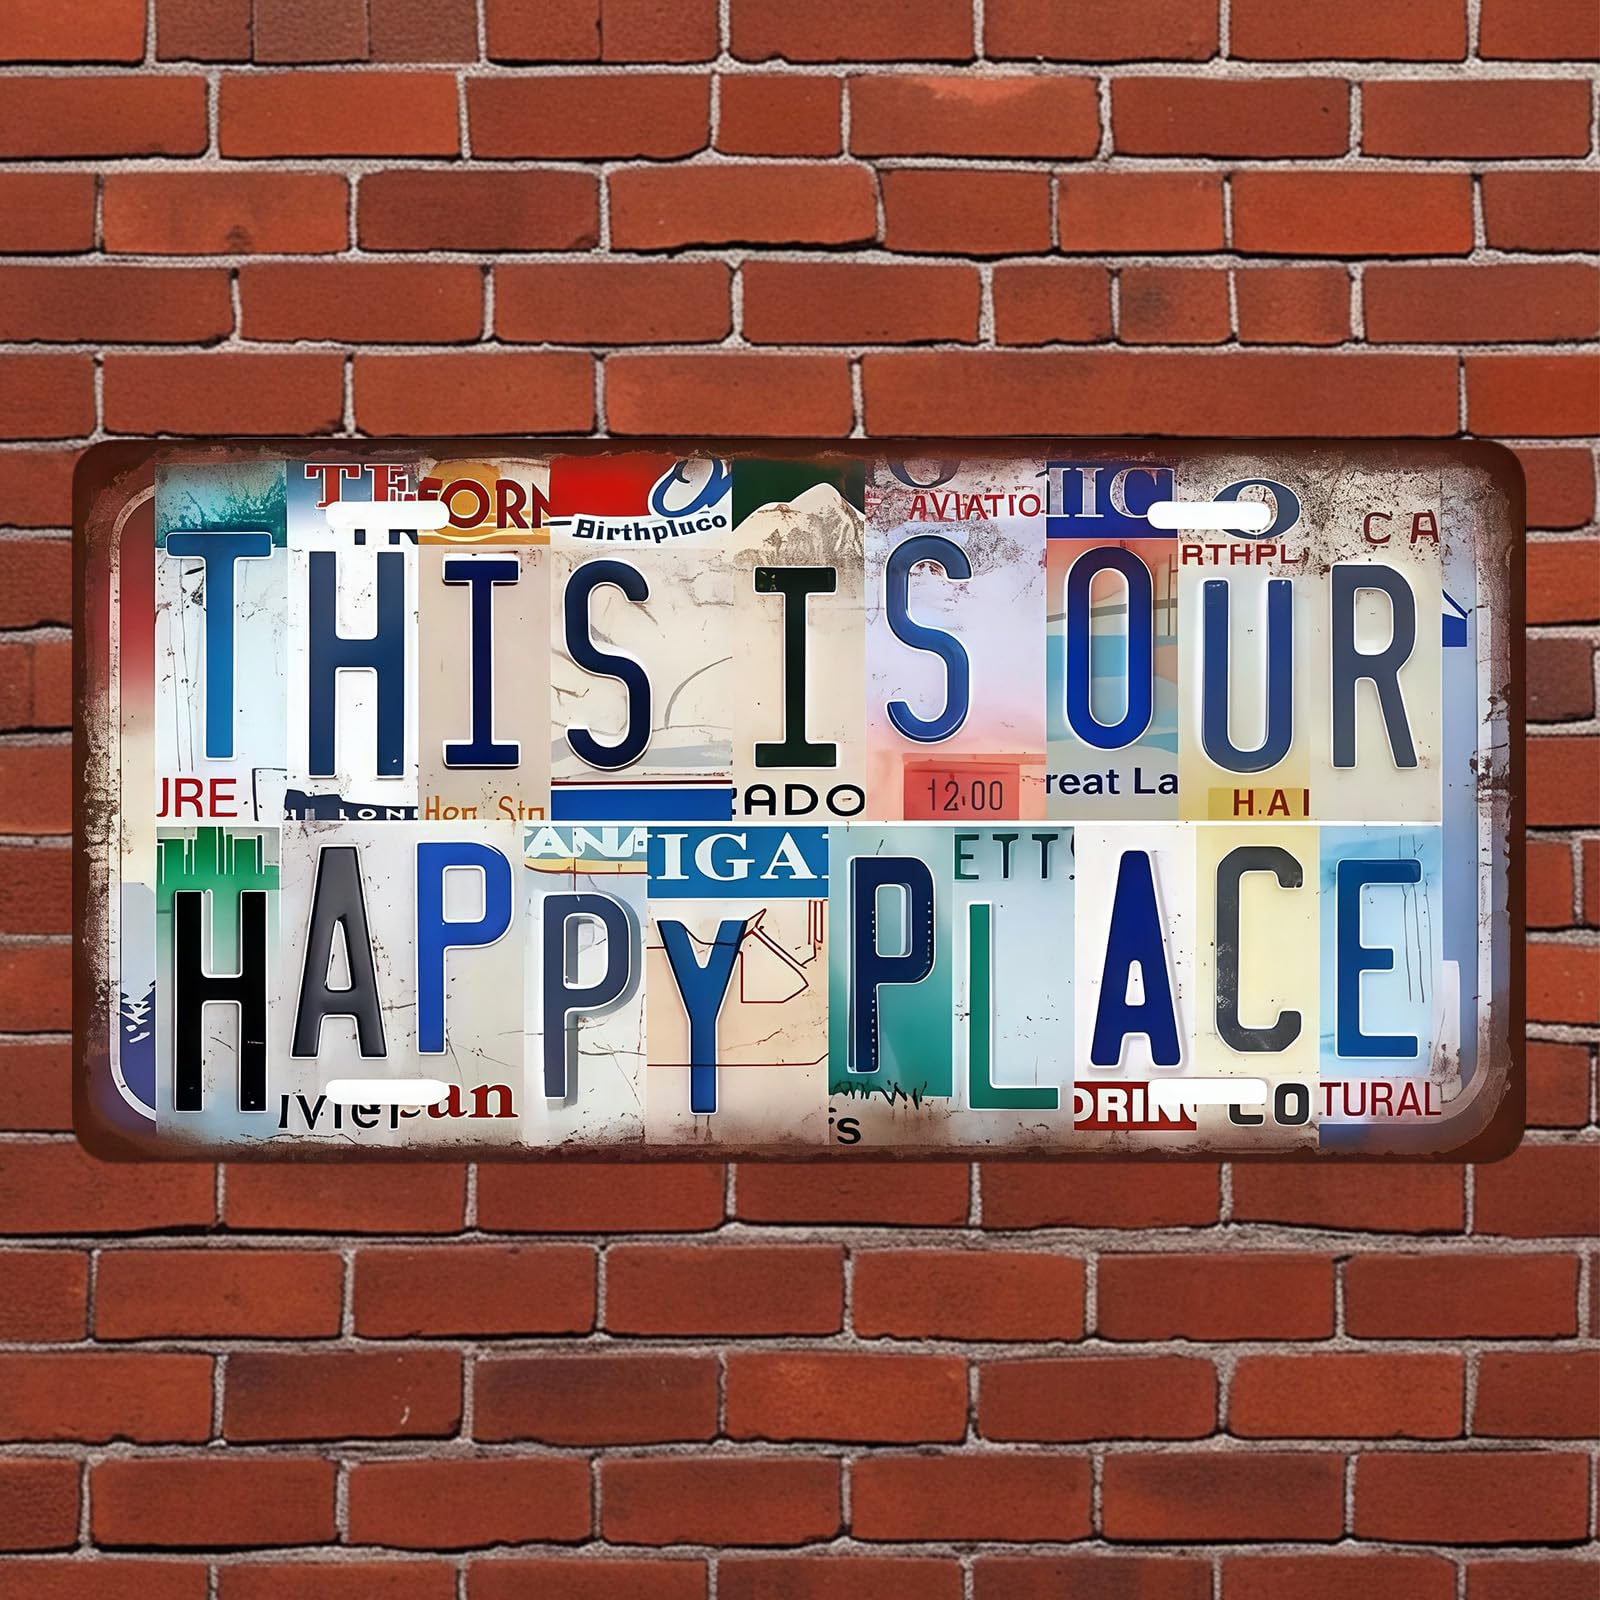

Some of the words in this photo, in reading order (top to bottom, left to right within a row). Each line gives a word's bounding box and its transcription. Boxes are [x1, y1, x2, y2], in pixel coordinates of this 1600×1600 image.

[167, 532, 651, 777] THIS
[755, 535, 972, 768] IS
[1066, 547, 1417, 772] OUR
[732, 784, 865, 816] ADO
[1134, 768, 1178, 794] La
[647, 832, 829, 881] IGA
[955, 834, 1074, 880] ETT
[174, 842, 747, 1113] HAPPY
[848, 846, 1421, 1109] PLACE
[1320, 1082, 1441, 1116] TURAL
